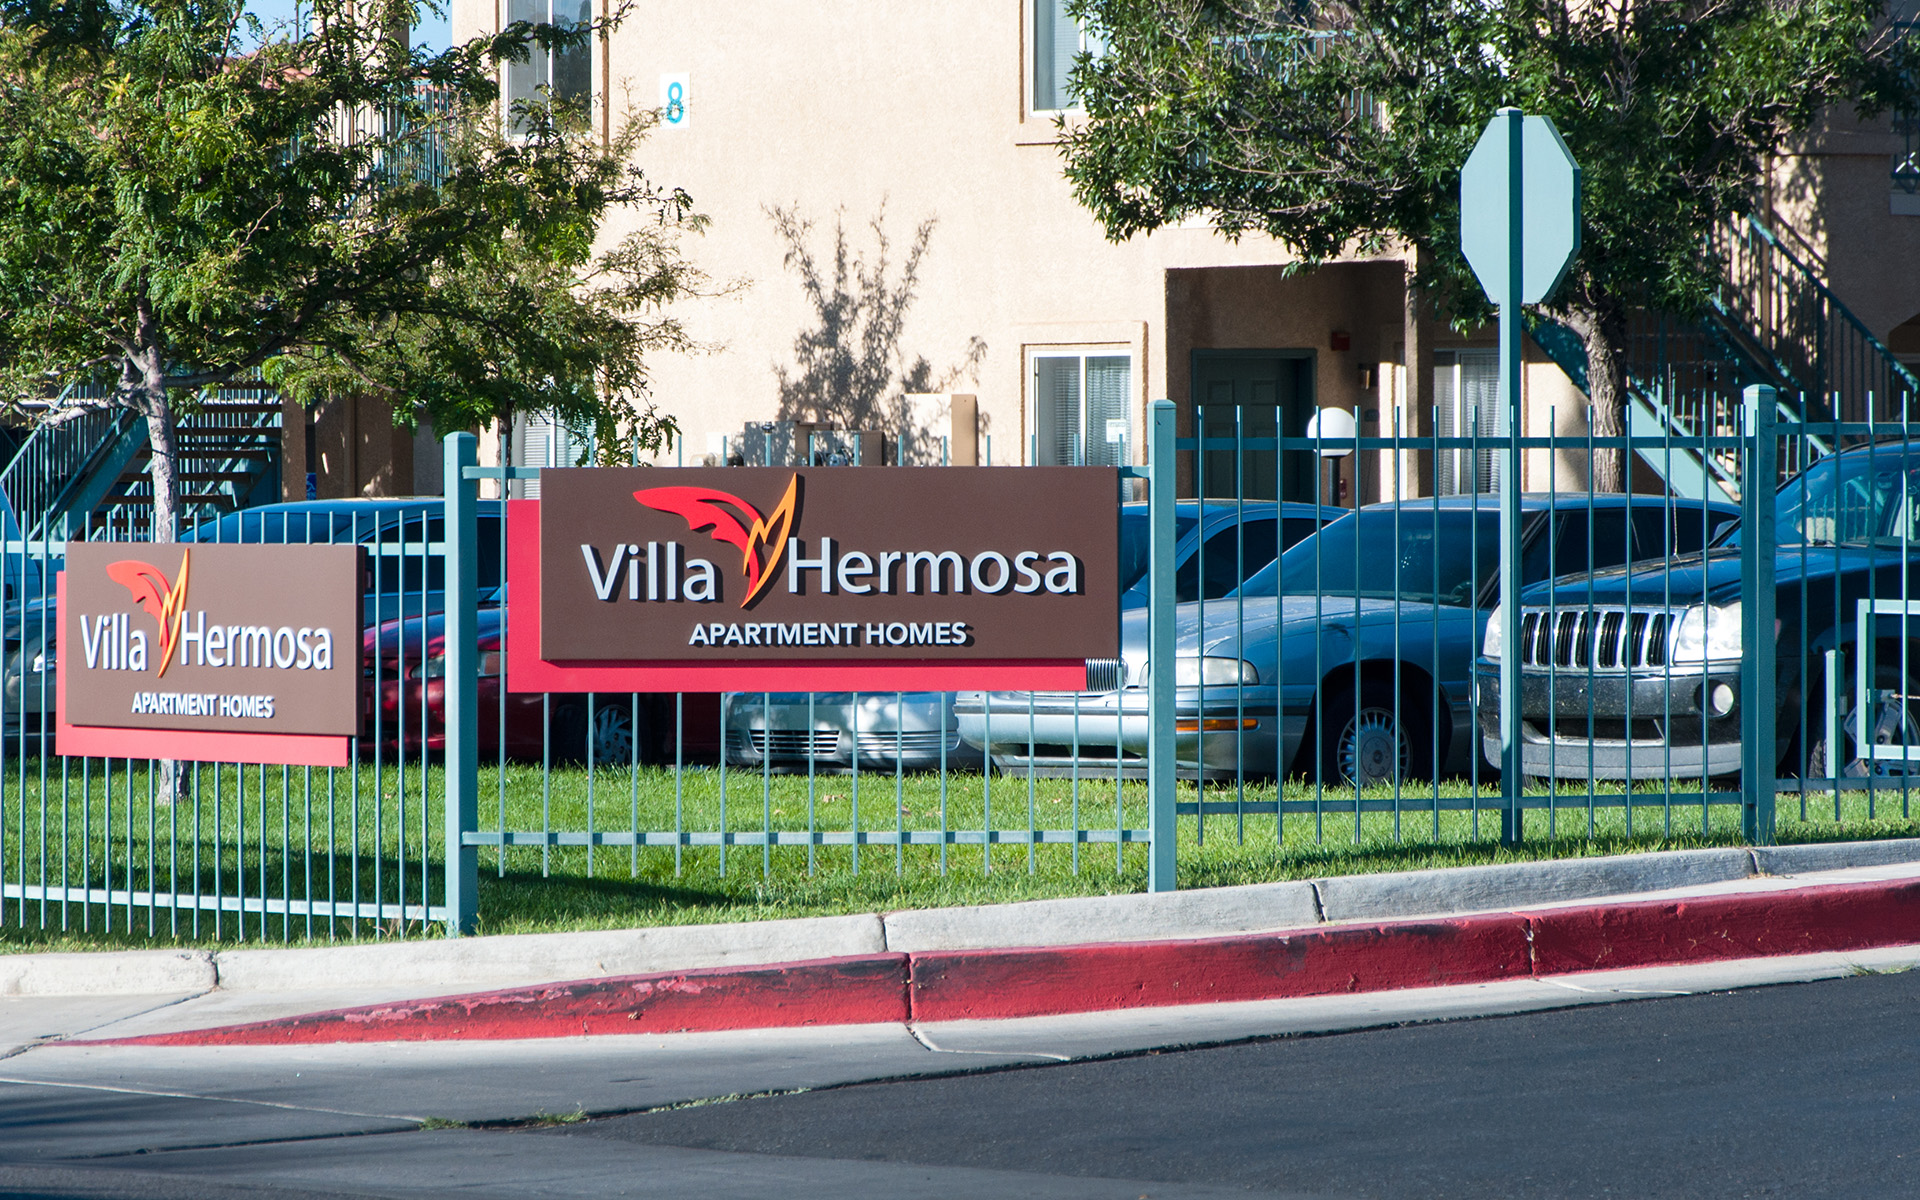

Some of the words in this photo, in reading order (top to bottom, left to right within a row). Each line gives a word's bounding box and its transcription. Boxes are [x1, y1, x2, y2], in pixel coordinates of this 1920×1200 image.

[667, 82, 684, 124] 8
[581, 541, 716, 601] Villa
[788, 537, 1078, 593] Hermosa
[80, 613, 149, 671] Villa
[180, 610, 334, 670] Hermosa
[688, 622, 858, 645] APARTMENT
[865, 622, 968, 645] HOMES
[131, 692, 218, 717] APARTMENT
[219, 695, 275, 718] HOMES
